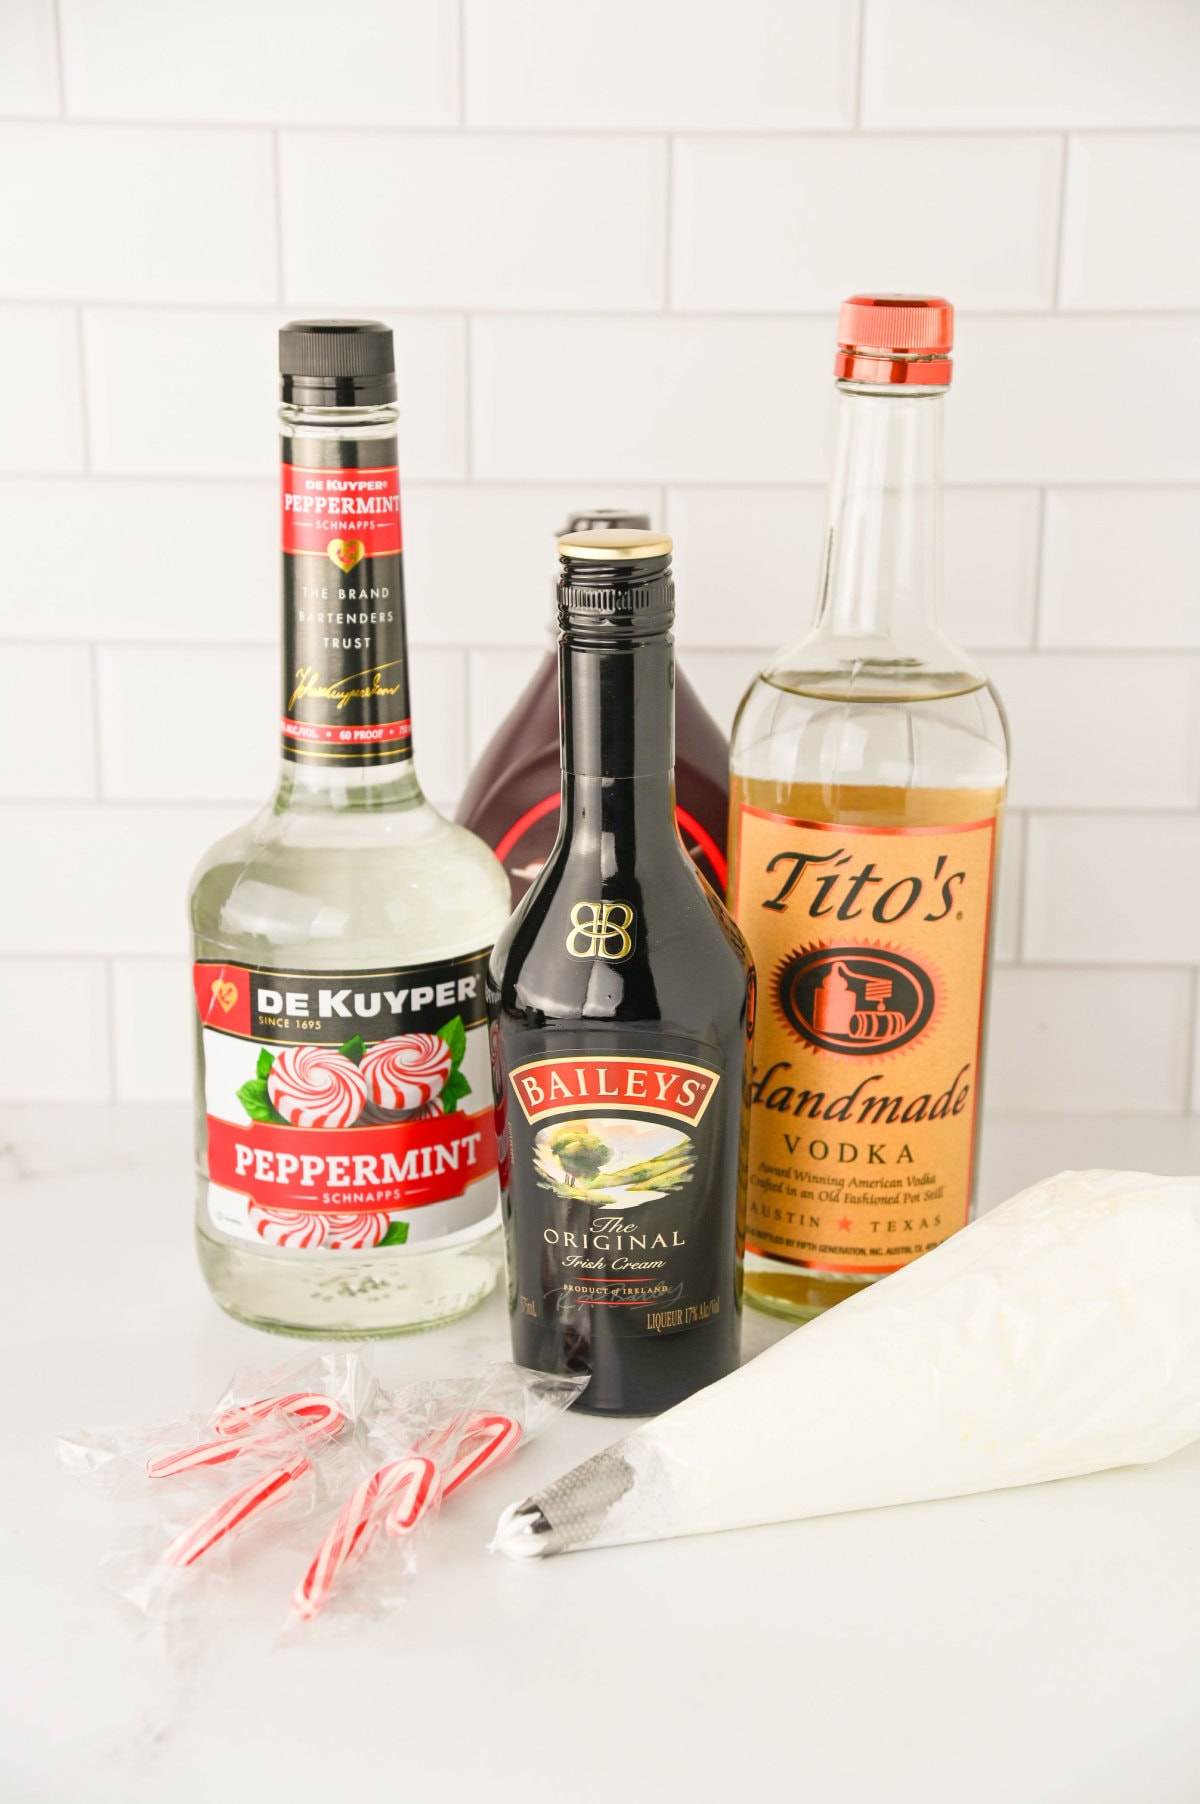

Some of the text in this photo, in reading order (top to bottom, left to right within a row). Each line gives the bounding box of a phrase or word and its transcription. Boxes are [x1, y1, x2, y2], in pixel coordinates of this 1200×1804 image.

[305, 479, 384, 491] DE KUYPER
[284, 493, 400, 514] PEPPERMINT
[315, 520, 375, 530] SCHNAPPS
[303, 587, 390, 600] THE BRAND
[298, 610, 394, 624] BARTENDERS
[323, 637, 372, 649] TRUST
[339, 730, 351, 741] 60
[353, 729, 384, 740] PROOF
[761, 848, 967, 924] Tito's
[257, 976, 478, 1018] DE KUYPER
[258, 1015, 322, 1030] SINCE 1695
[521, 1067, 703, 1108] BAILEYS
[783, 1134, 915, 1165] VODKA
[234, 1132, 481, 1187] PEPPERMINT
[758, 1161, 937, 1189] Award Winning American Vodka
[322, 1188, 401, 1204] SCHNAPPS
[750, 1174, 944, 1205] Crafted in an Old Fashioned Pot Still
[589, 1216, 639, 1234] The
[750, 1202, 942, 1233] AUSTIN TEXAS
[543, 1228, 686, 1251] ORIGINAL
[561, 1255, 667, 1271] Irish Cream
[563, 1284, 668, 1296] PRODUCT of IRELAND
[647, 1309, 683, 1333] LIQUEUR
[685, 1305, 698, 1324] 17%
